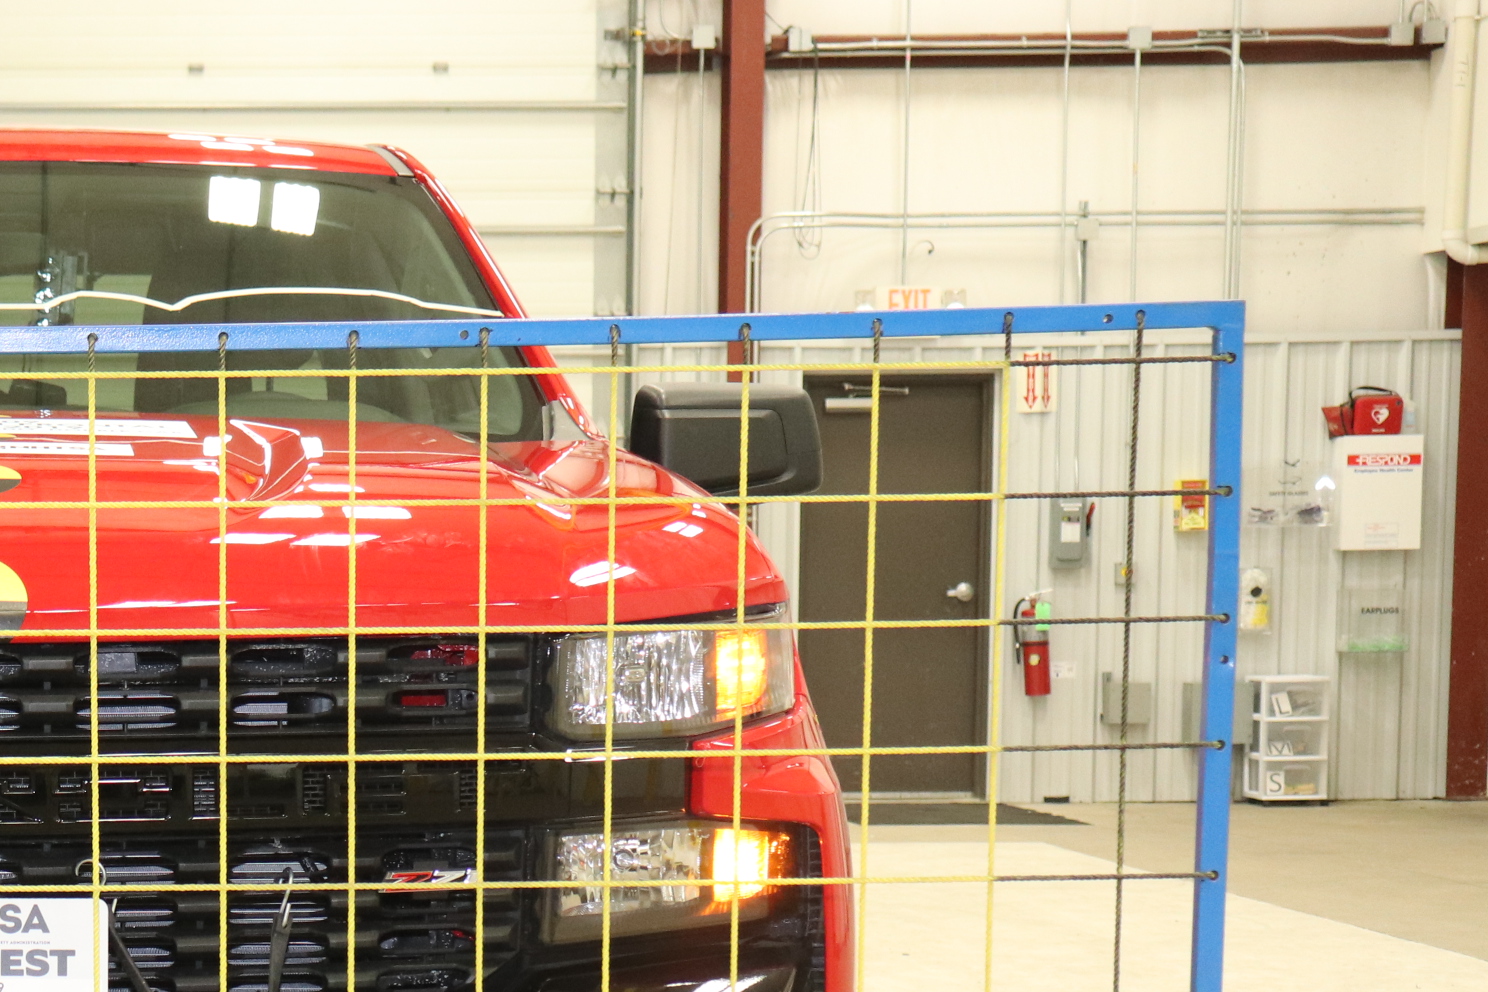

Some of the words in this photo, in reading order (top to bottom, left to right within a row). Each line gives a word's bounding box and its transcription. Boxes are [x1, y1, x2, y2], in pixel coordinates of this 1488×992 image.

[888, 288, 931, 310] EXIT
[1359, 454, 1411, 467] RESPOND
[1269, 772, 1282, 793] S
